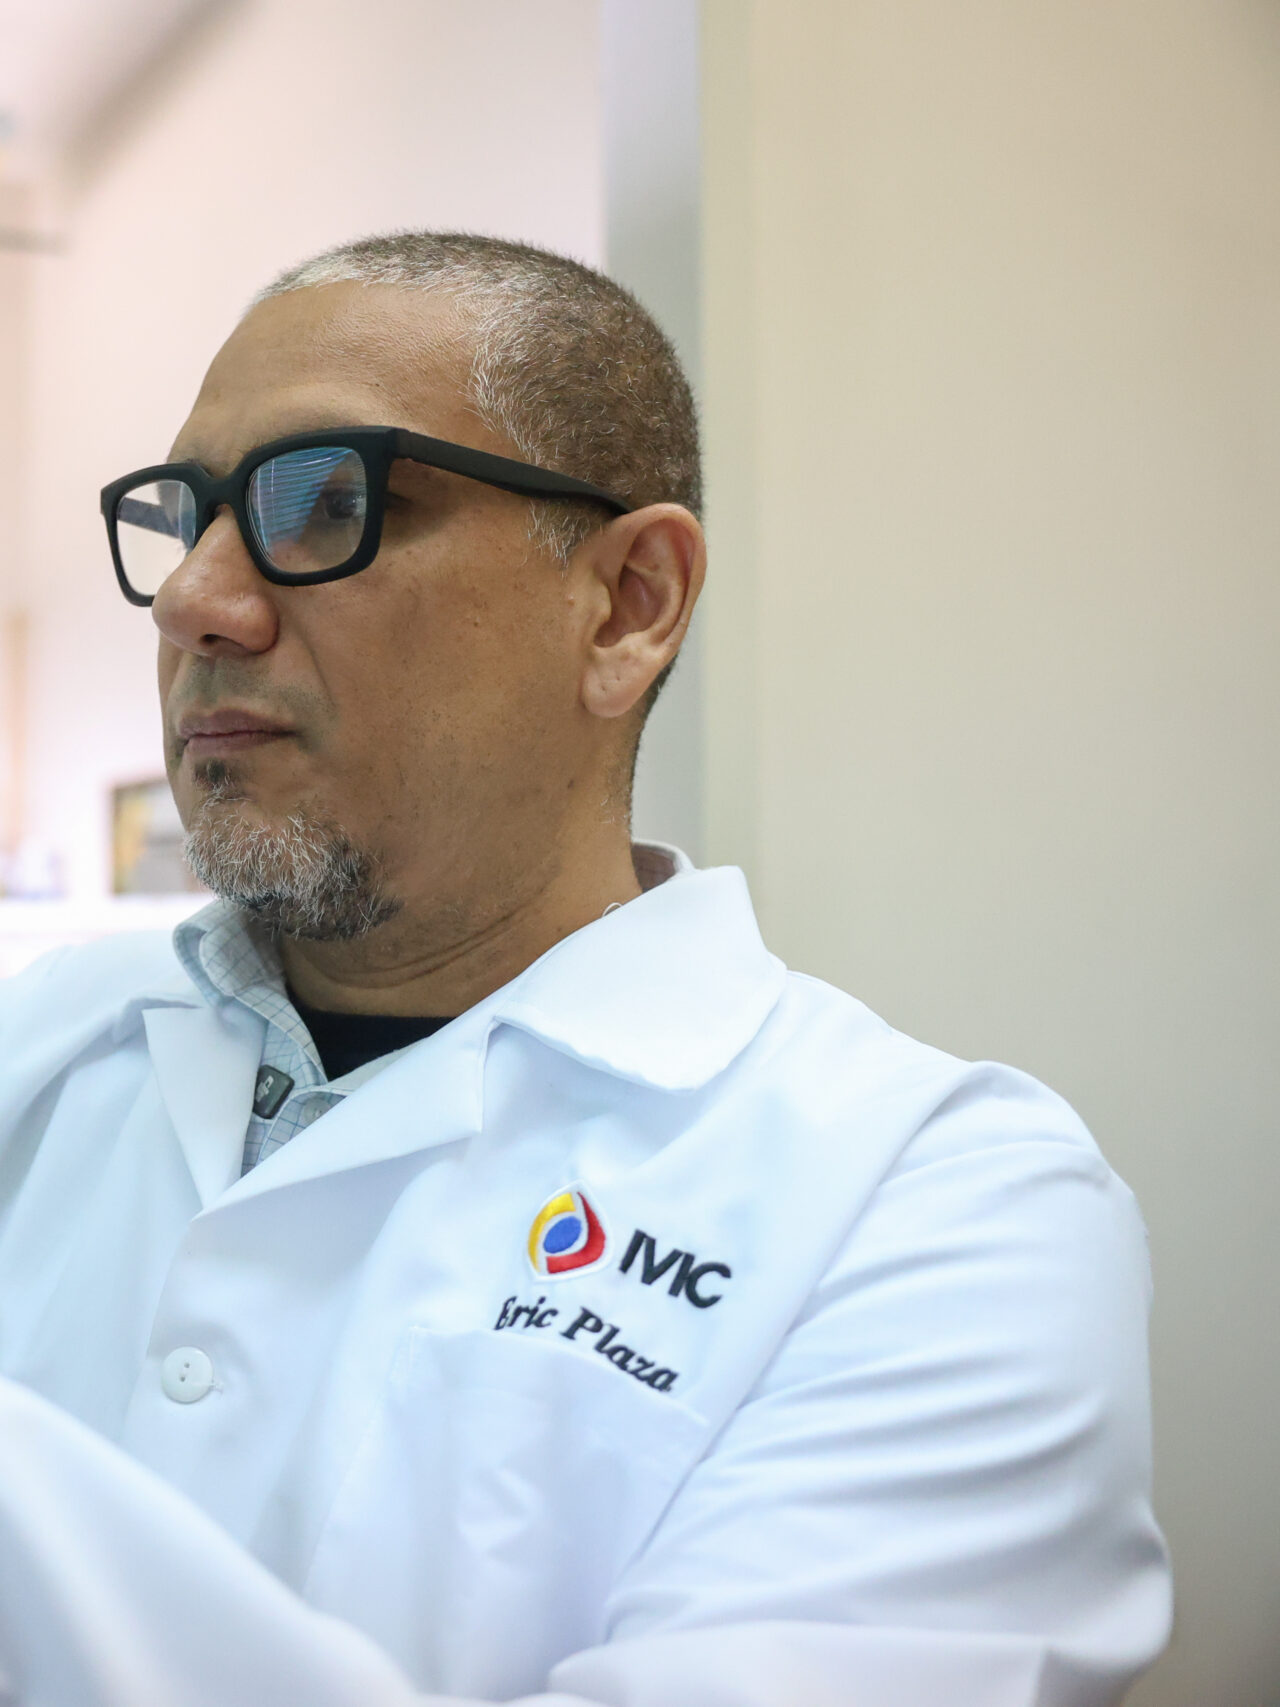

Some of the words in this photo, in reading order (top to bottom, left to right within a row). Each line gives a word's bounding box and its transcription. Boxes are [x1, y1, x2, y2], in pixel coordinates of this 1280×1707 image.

[619, 1228, 732, 1309] IVIC
[493, 1295, 559, 1331] Eric
[559, 1306, 679, 1393] Plaza
